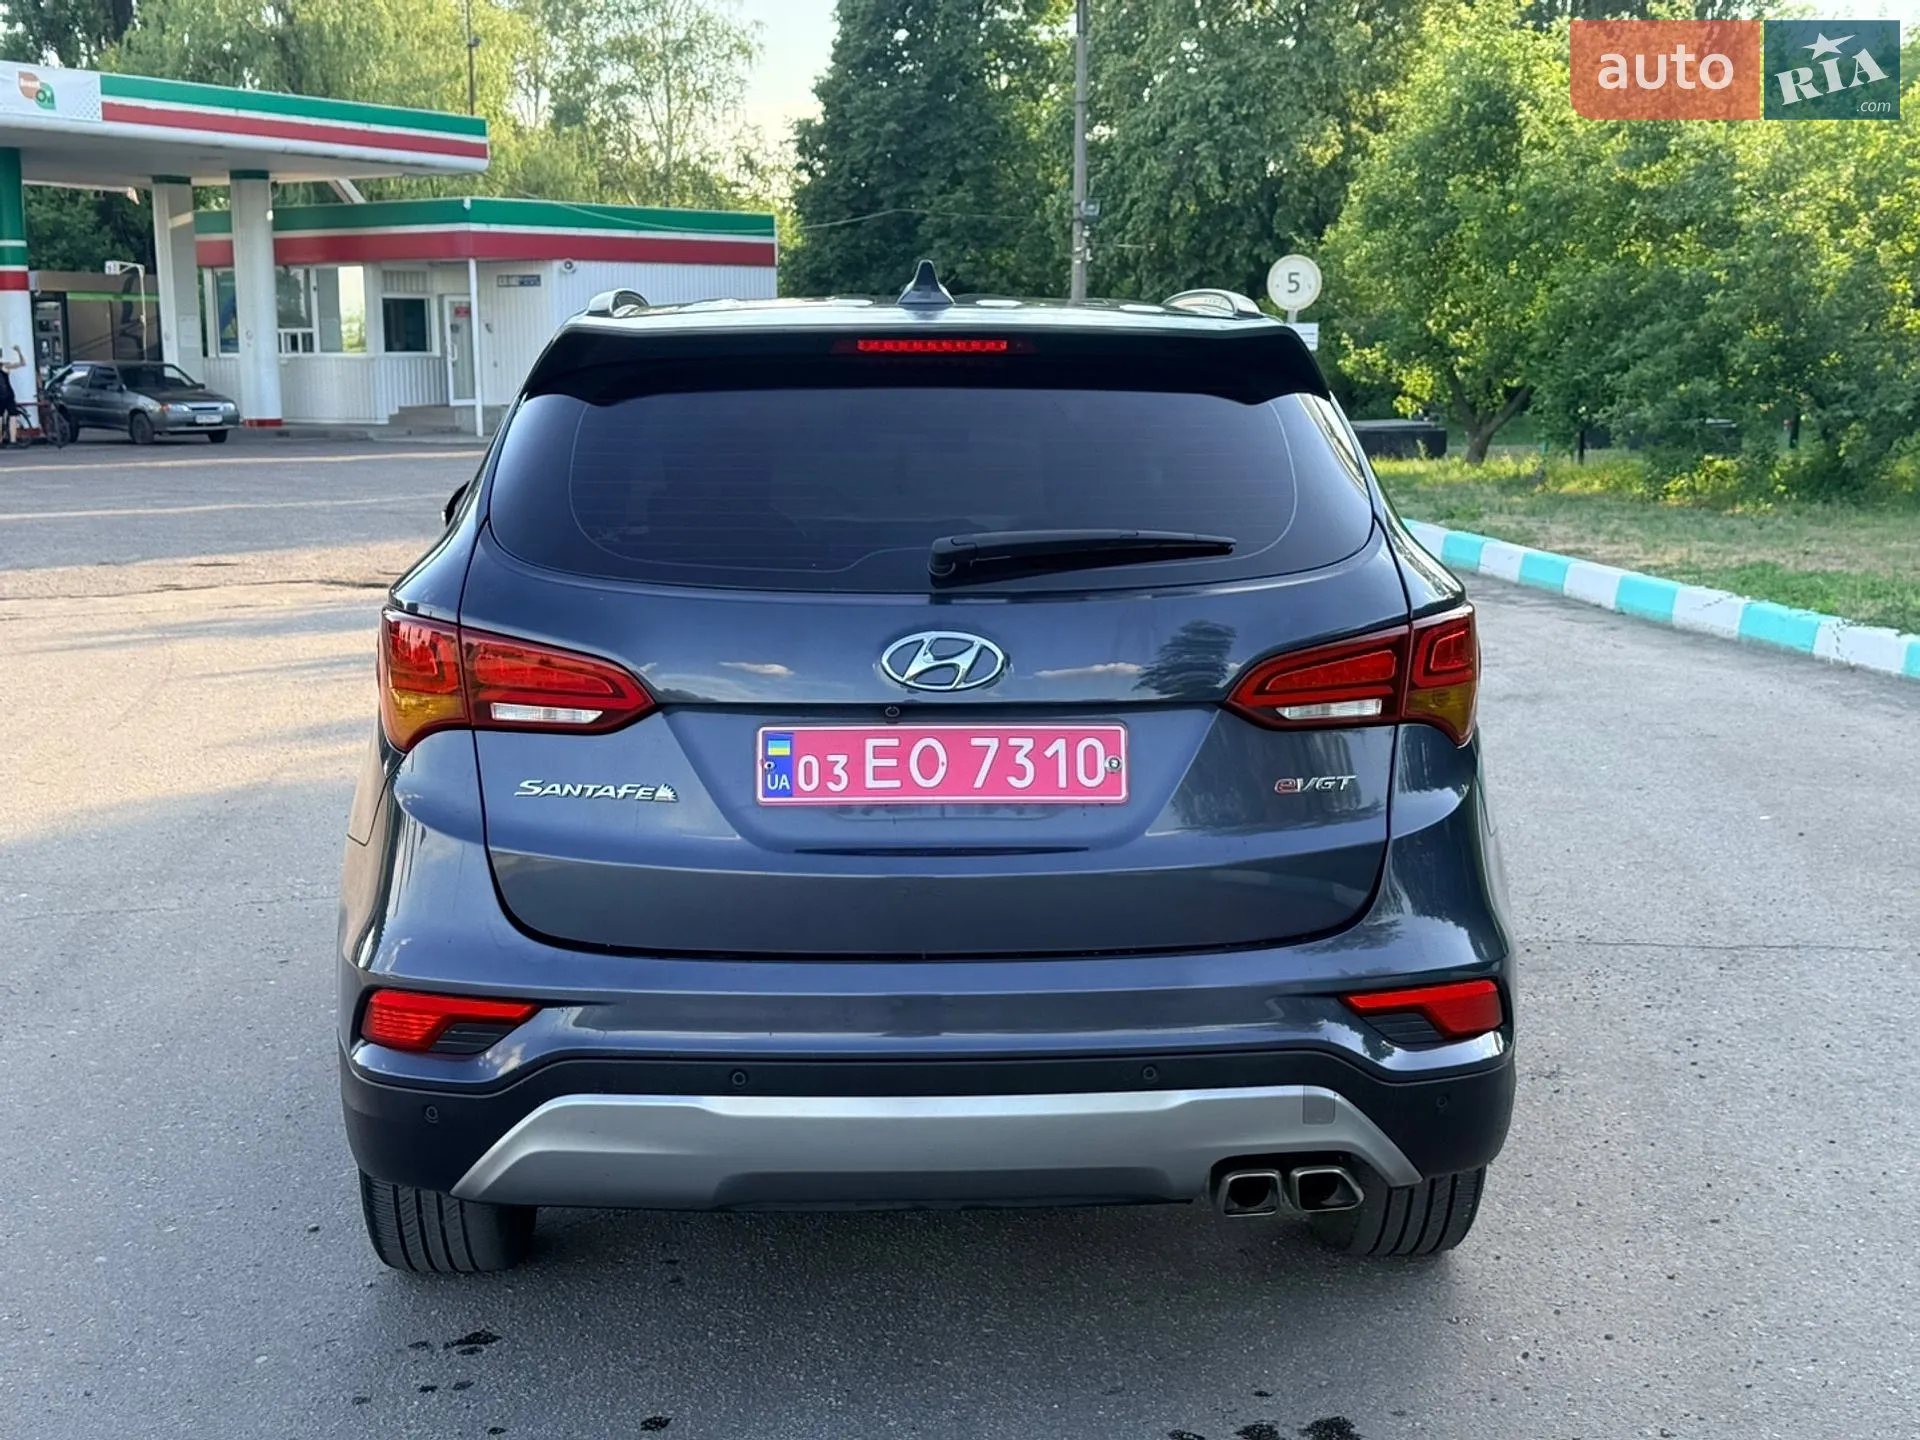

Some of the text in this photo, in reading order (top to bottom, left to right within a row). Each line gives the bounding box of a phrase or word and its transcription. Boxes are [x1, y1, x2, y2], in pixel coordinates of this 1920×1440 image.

[1287, 271, 1301, 294] 5
[797, 737, 1107, 792] 03 EO 7310
[766, 774, 790, 790] UA
